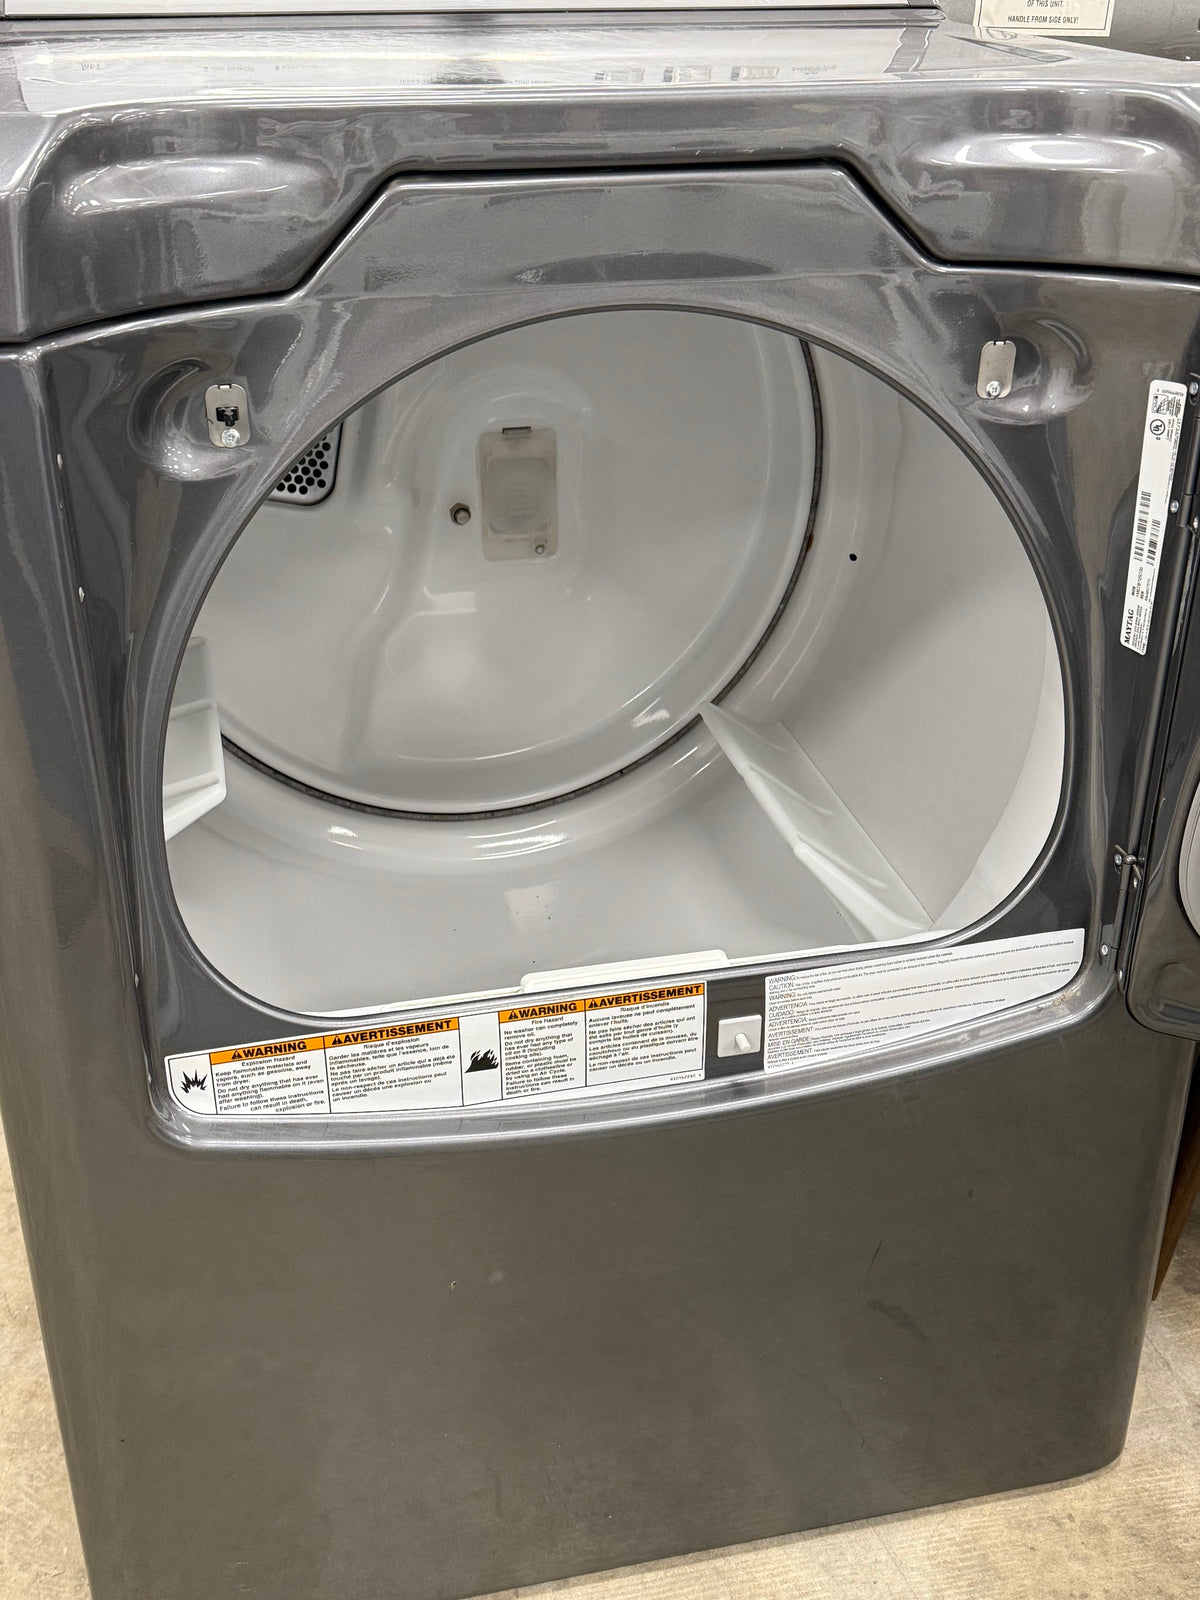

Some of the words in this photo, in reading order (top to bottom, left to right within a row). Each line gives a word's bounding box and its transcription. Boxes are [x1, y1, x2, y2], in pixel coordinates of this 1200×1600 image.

[1124, 608, 1134, 644] MAYTAG
[768, 974, 795, 984] WARNING:
[768, 981, 794, 990] CAUTION:
[600, 986, 700, 1005] AVERTISSEMENT
[768, 991, 795, 1001] WARNING:
[519, 1003, 576, 1016] WARNING
[768, 1009, 794, 1018] CUIDADO:
[344, 1021, 451, 1042] AVERTISSEMENT
[767, 1026, 814, 1038] AVERTISSEMENT:
[243, 1042, 306, 1056] WARNING
